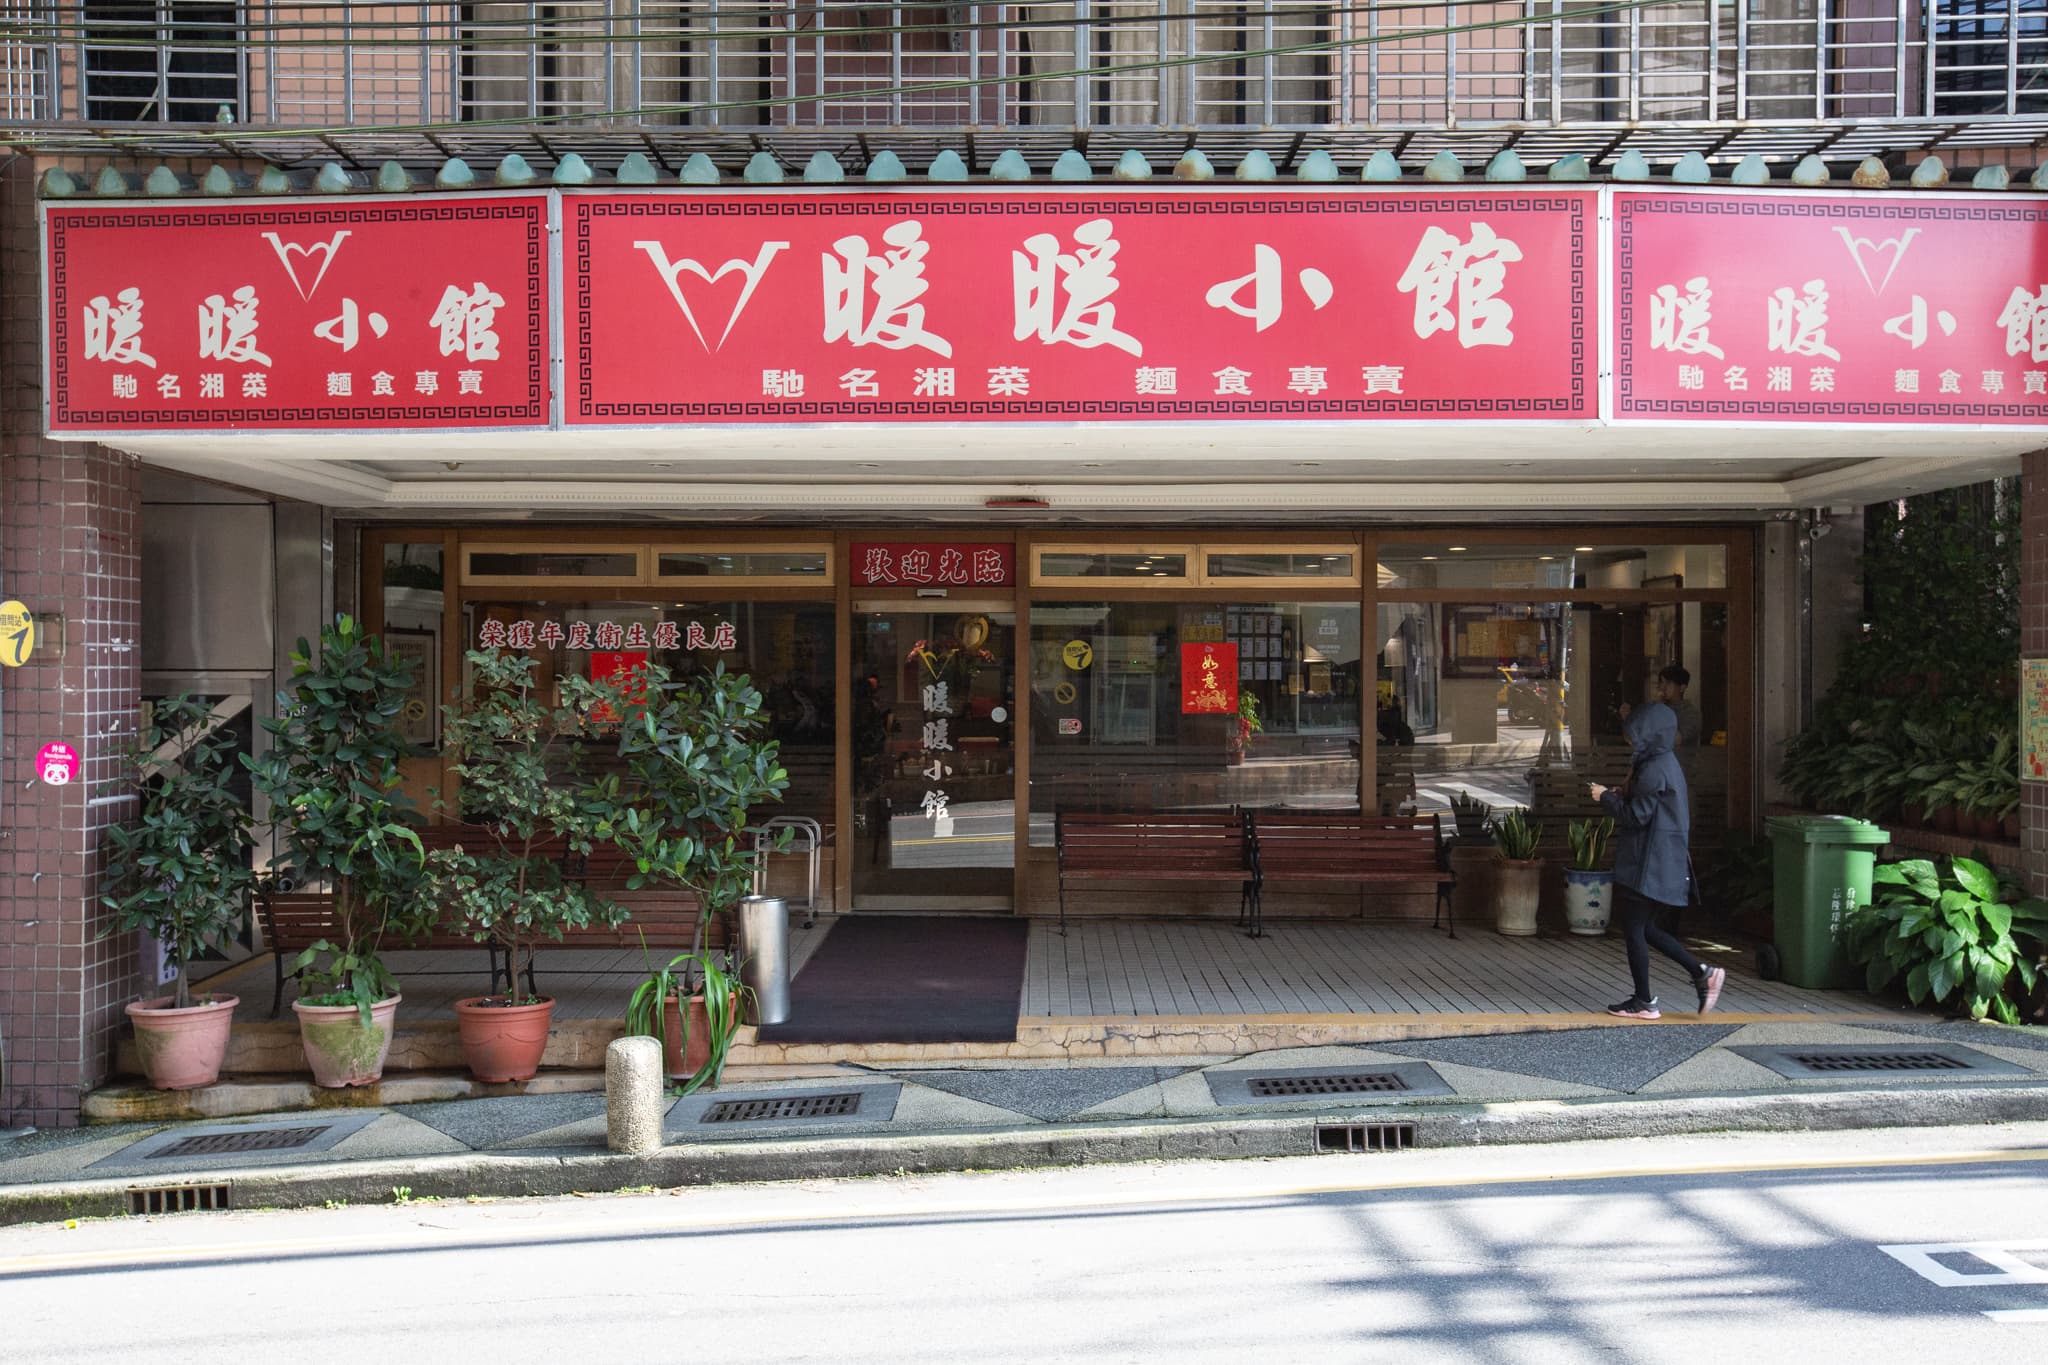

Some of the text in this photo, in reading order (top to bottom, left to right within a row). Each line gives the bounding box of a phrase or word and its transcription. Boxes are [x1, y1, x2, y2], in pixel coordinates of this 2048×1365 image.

[822, 219, 1523, 358] 暖暖小館
[84, 282, 506, 368] 暖暖小館
[113, 370, 483, 398] 馳名湘菜 麵食專賣
[763, 365, 1403, 397] 馳名湘菜 麵食專賣
[1679, 365, 2046, 394] 馳名湘菜 麵食專賣
[863, 549, 1005, 583] 歡迎光臨
[480, 620, 737, 650] 榮獲年度衛生優良店
[1202, 654, 1219, 689] 如意
[920, 681, 953, 820] 暖暖小館
